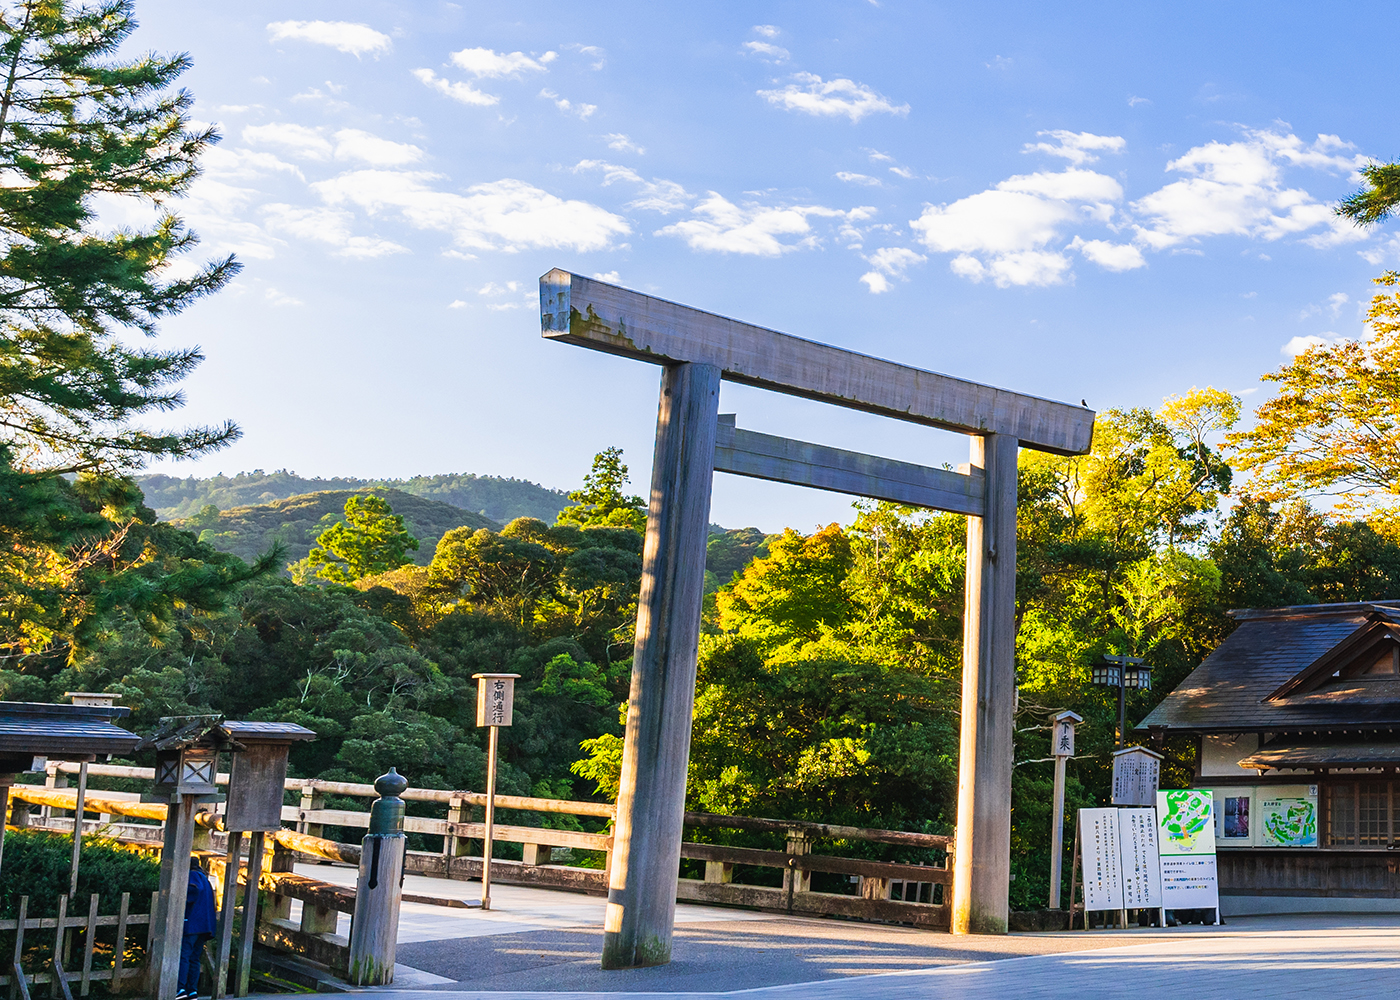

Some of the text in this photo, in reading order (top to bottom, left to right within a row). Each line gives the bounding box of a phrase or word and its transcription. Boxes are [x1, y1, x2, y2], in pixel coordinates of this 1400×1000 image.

[492, 680, 505, 723] 右側通行
[1060, 722, 1070, 751] 下乗
